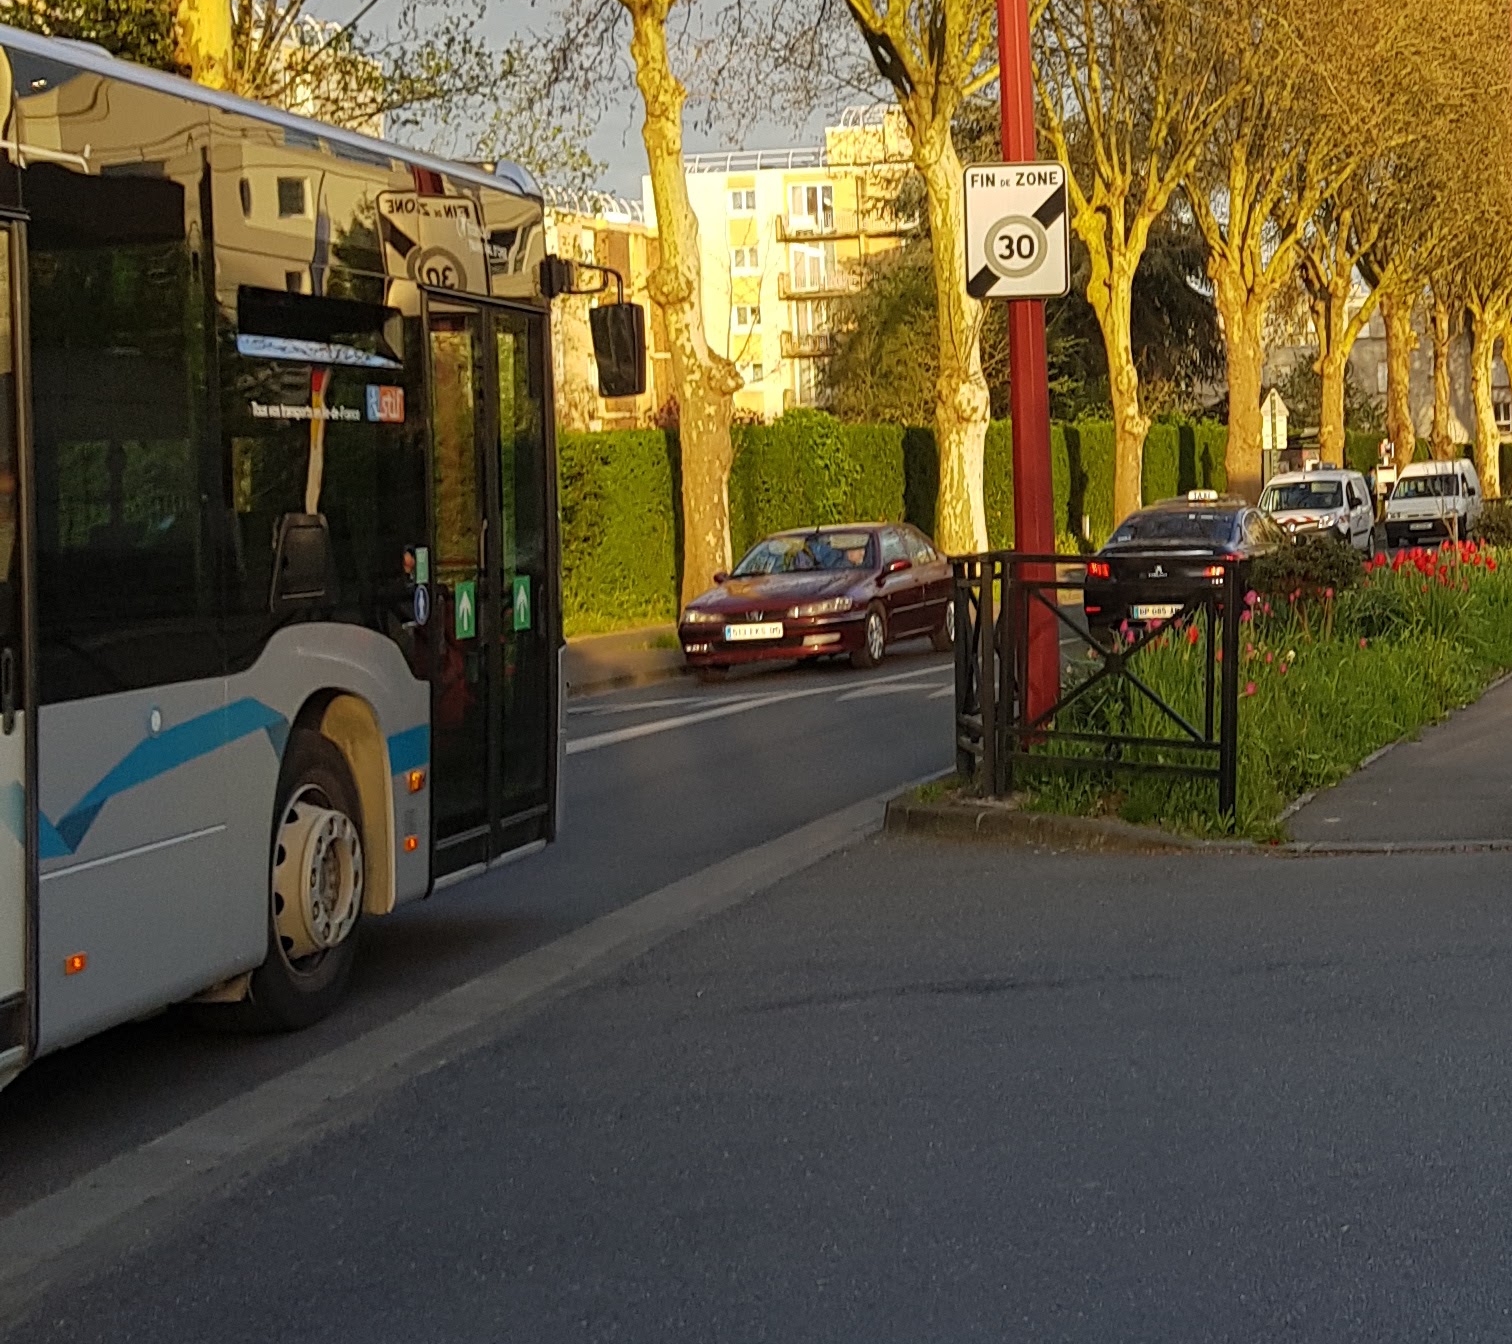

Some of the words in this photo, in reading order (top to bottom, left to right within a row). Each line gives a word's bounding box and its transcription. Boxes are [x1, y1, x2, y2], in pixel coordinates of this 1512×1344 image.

[970, 172, 996, 188] FIN
[1000, 178, 1011, 188] DE
[1015, 170, 1059, 187] ZONE
[997, 234, 1035, 260] 30
